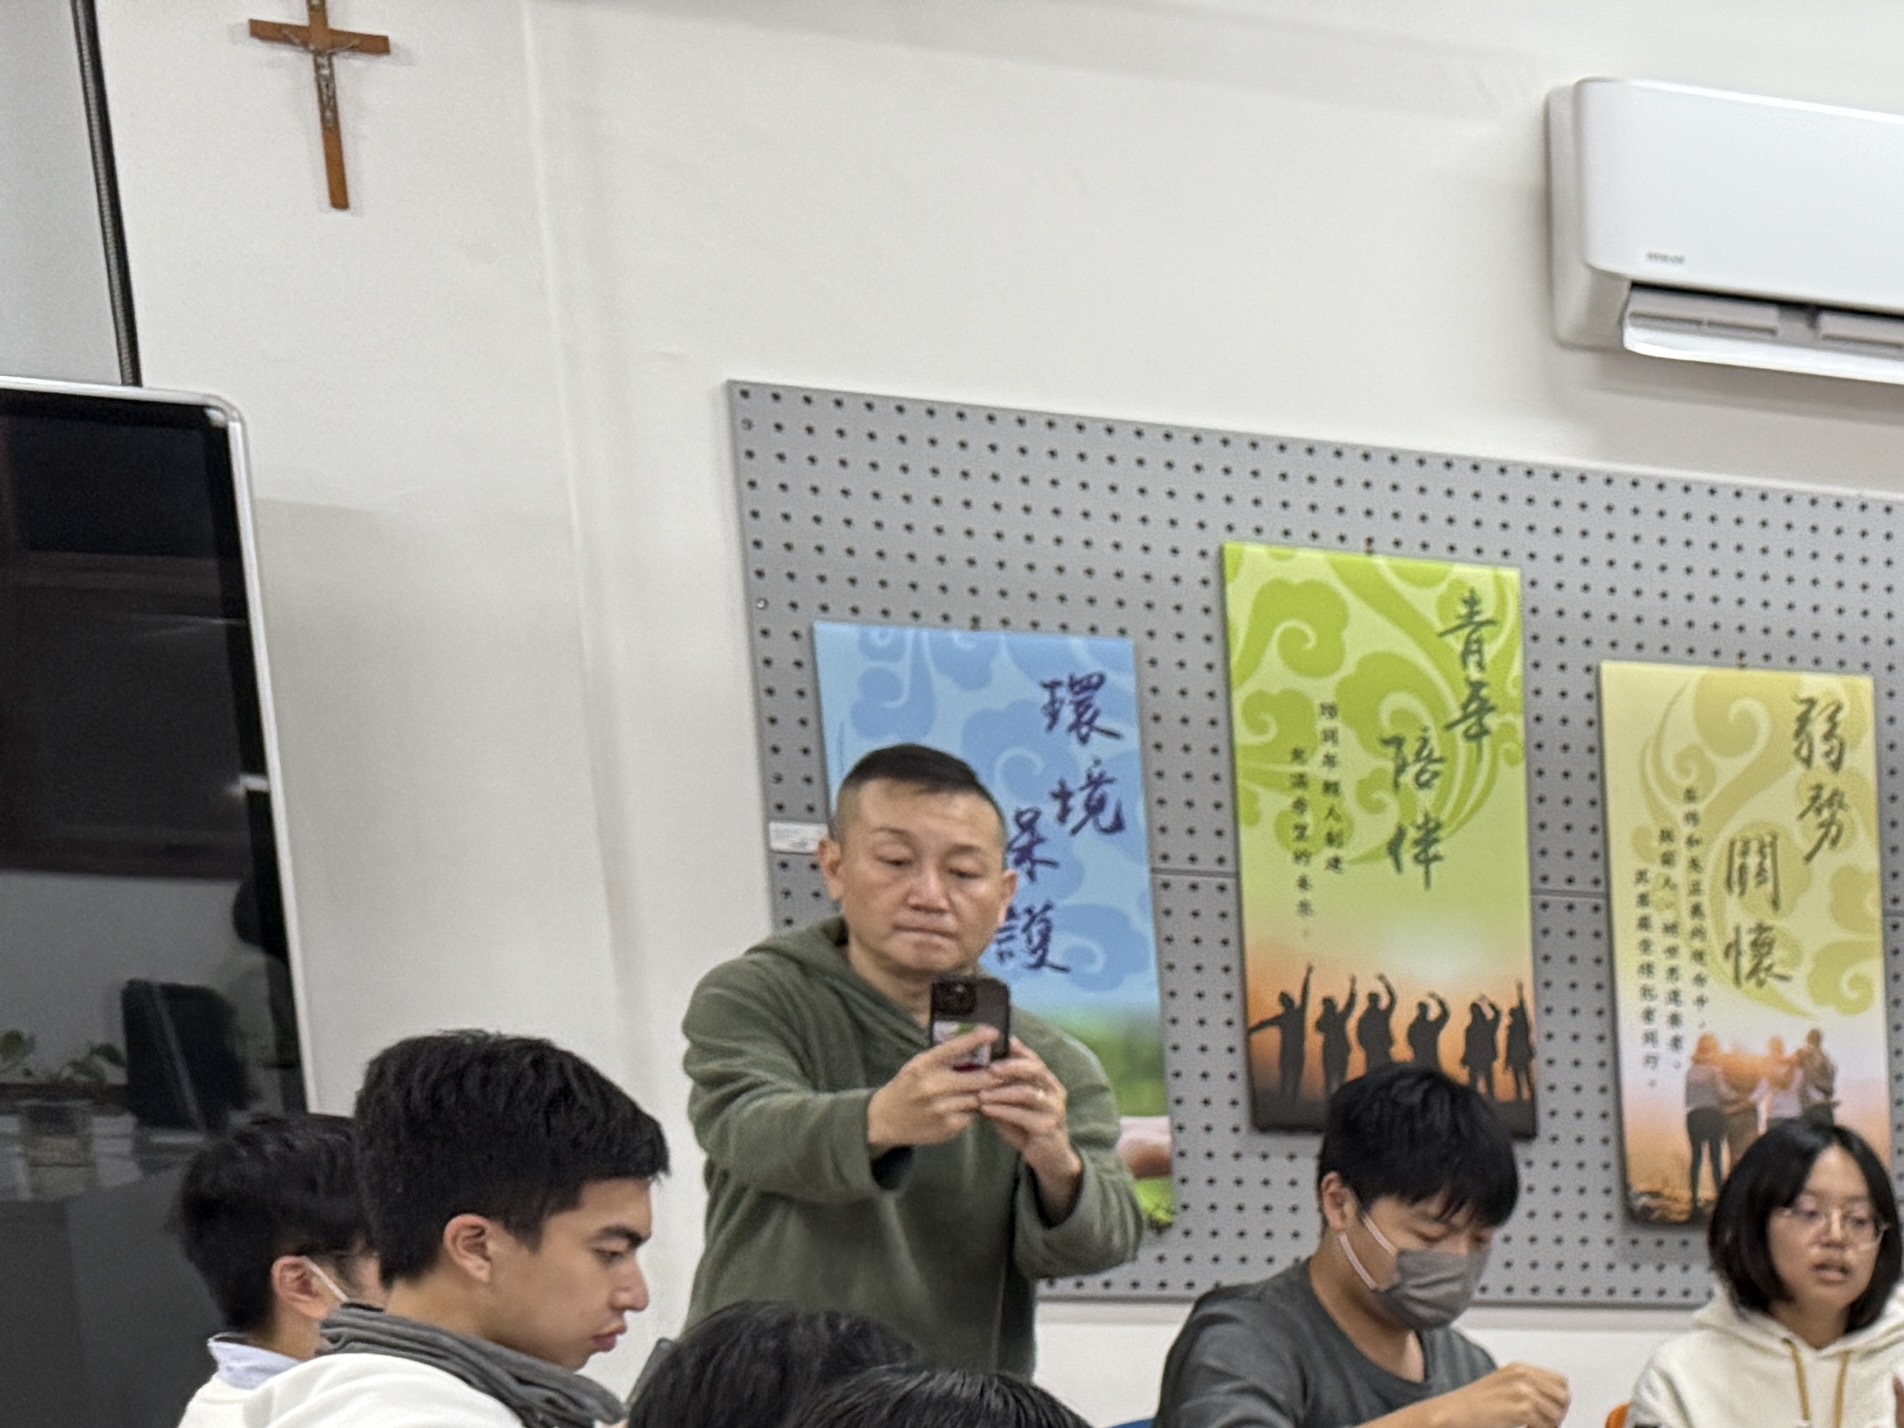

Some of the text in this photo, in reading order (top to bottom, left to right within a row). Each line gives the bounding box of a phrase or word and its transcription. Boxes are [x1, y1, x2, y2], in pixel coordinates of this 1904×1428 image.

[1041, 671, 1125, 837] 環境
[1439, 586, 1498, 765] 青年
[1380, 726, 1447, 891] 陪伴
